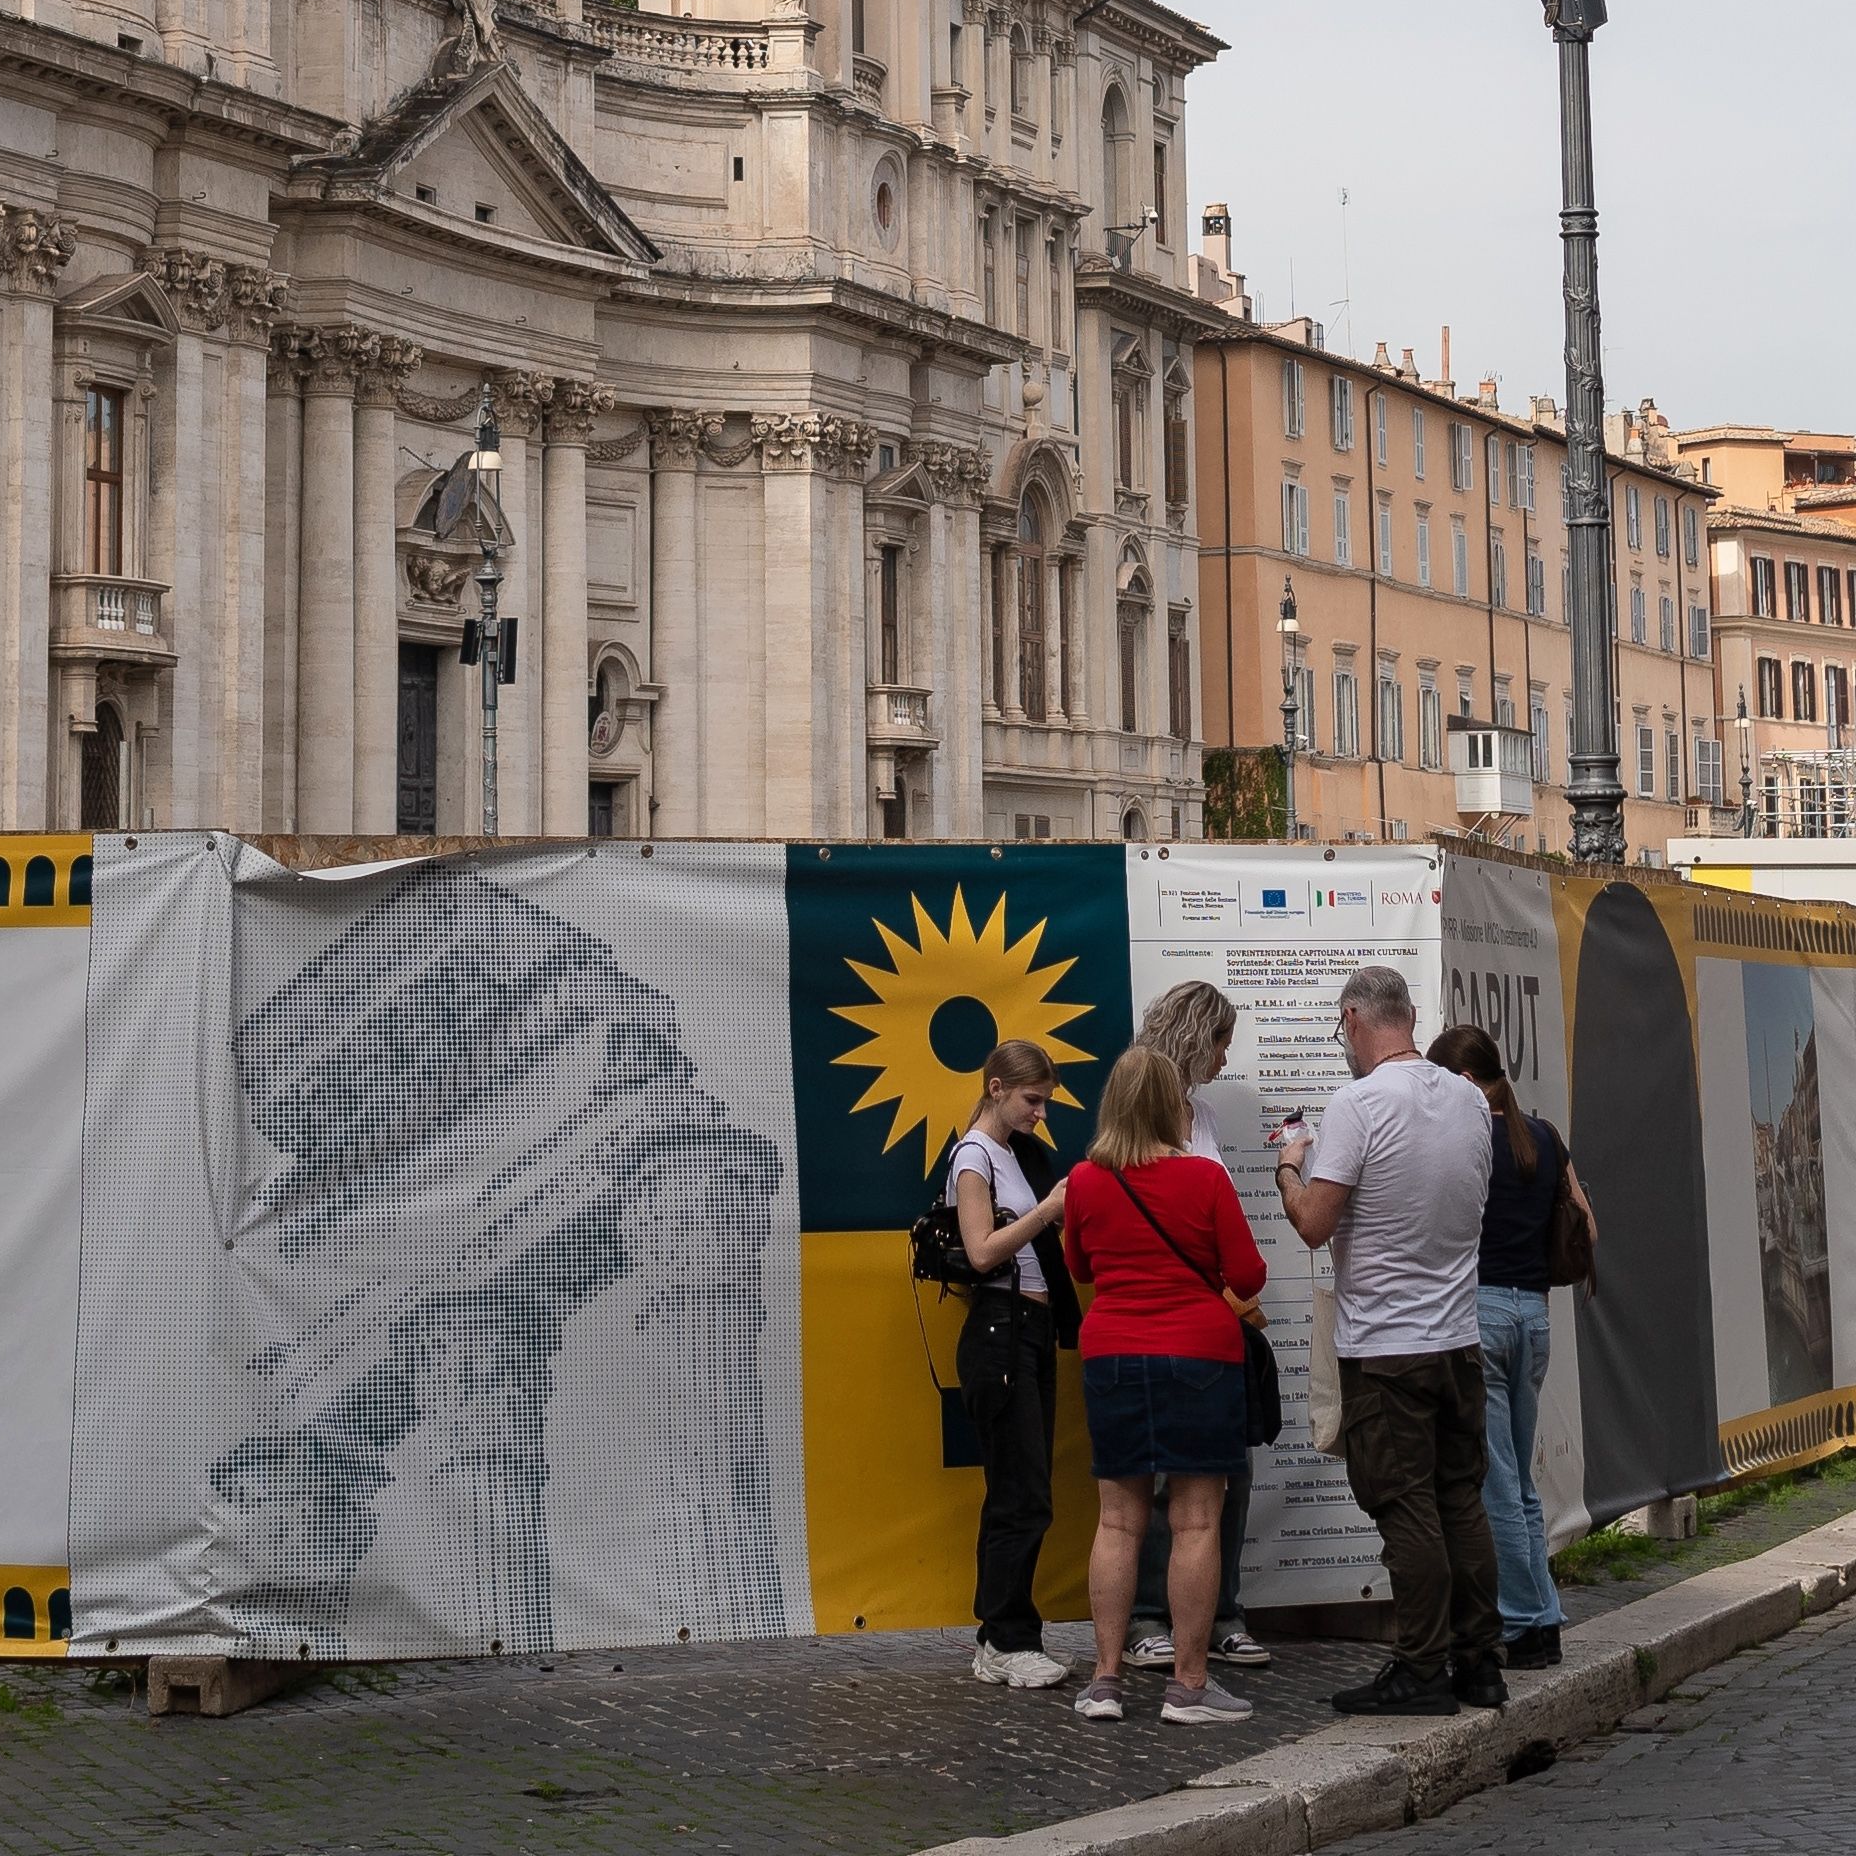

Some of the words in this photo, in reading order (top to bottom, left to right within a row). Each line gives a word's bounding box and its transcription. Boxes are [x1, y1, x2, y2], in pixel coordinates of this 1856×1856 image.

[1381, 892, 1424, 905] ROMA
[1162, 949, 1214, 958] Committente:
[1226, 949, 1296, 957] SOVRINTENDENZA
[1299, 949, 1344, 957] CAPITOLINA
[1377, 948, 1418, 956] CULTURALI
[1227, 959, 1274, 967] Sovrintende:
[1329, 958, 1359, 966] Presicce
[1266, 978, 1286, 986] Fabio
[1288, 978, 1319, 986] Pacciani
[1258, 1035, 1291, 1043] Emiliano
[1294, 1035, 1326, 1043] Africano
[1271, 1339, 1298, 1348] Marina
[1284, 1365, 1310, 1375] Angela
[1274, 1458, 1296, 1466] Arch.
[1297, 1456, 1321, 1465] Nicola
[1316, 1494, 1346, 1502] Vanessa
[1311, 1527, 1343, 1535] Cristina
[1344, 1525, 1377, 1534] Polimen
